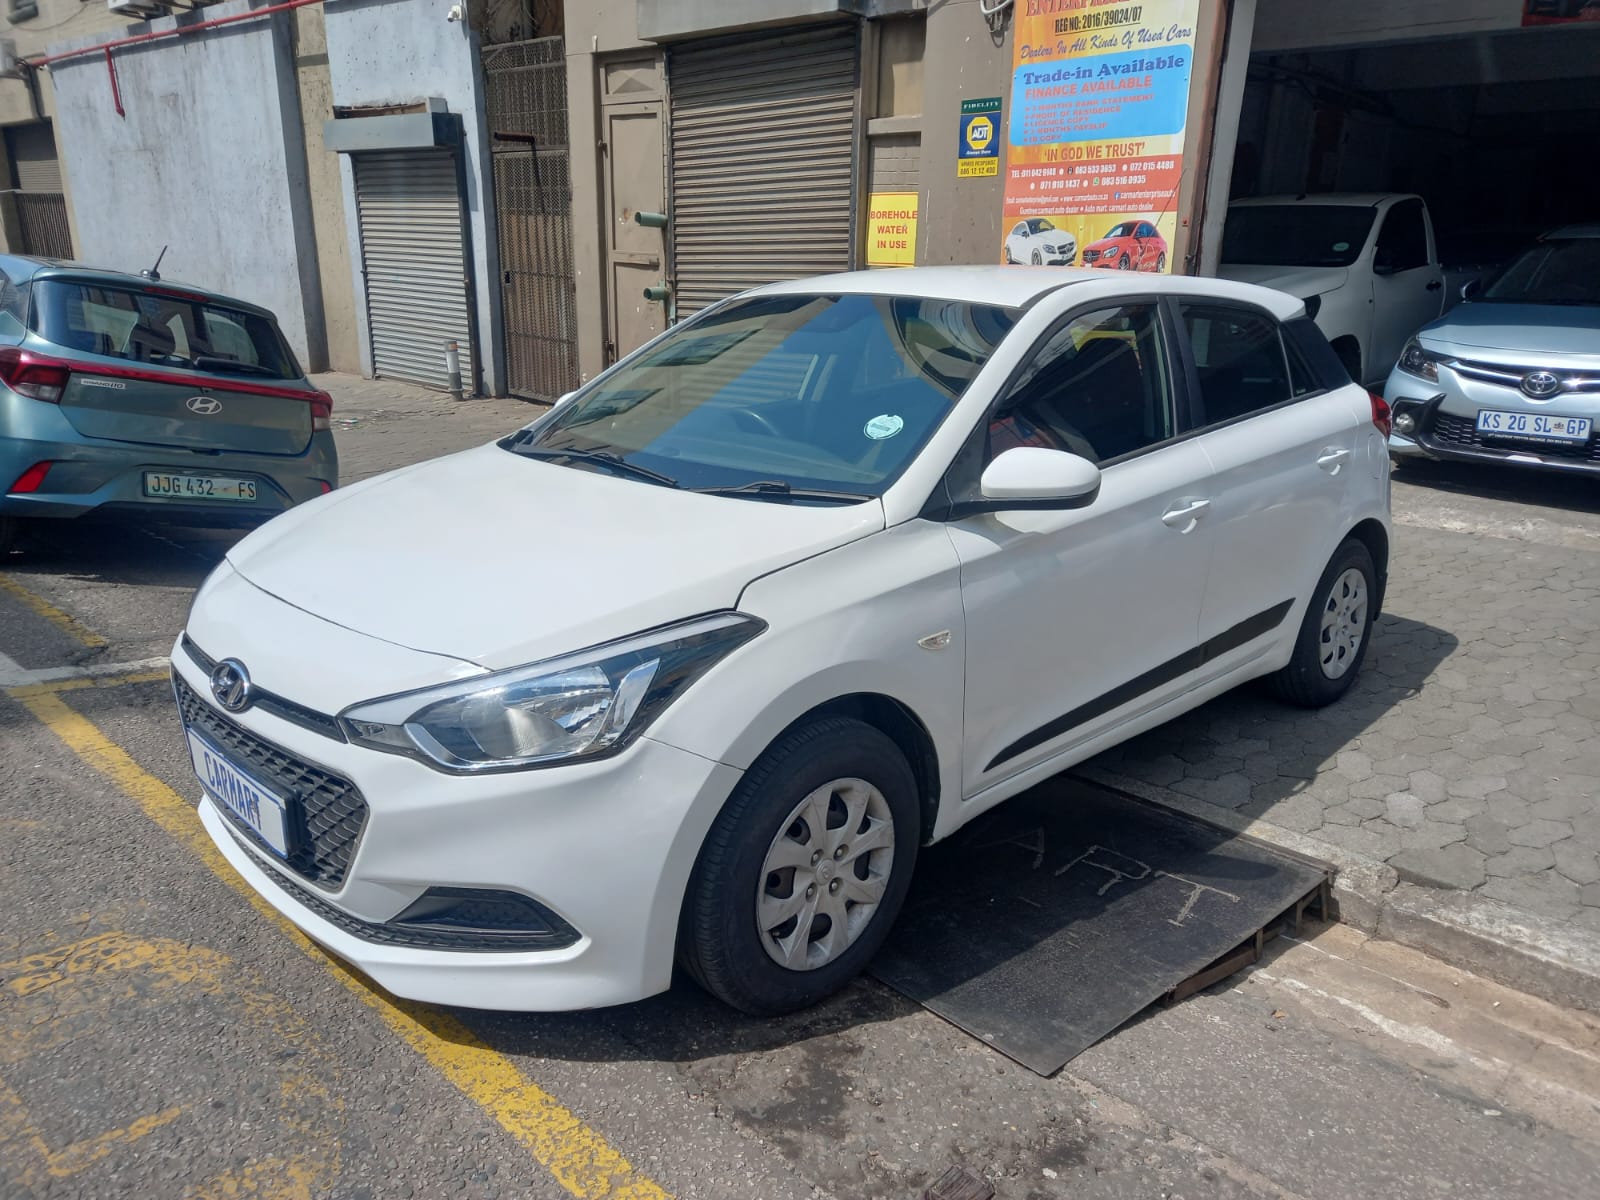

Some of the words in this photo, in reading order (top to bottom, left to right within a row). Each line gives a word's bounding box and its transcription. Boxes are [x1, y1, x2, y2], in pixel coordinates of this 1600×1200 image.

[1055, 18, 1069, 33] REG
[1082, 6, 1142, 28] 2016/39024/07
[1021, 44, 1053, 59] Dealers
[1057, 42, 1067, 55] In
[1068, 38, 1086, 54] All
[1090, 35, 1117, 49] Kinds
[1121, 31, 1134, 49] Of
[1138, 28, 1163, 43] Used
[1166, 24, 1191, 41] Cars
[1024, 66, 1093, 85] Trade-in
[1097, 55, 1185, 77] Available
[1025, 84, 1077, 99] FINANCE
[1081, 75, 1153, 94] AVAILABLE
[972, 126, 989, 139] ADT
[1061, 146, 1083, 160] GOD
[1086, 144, 1102, 159] WE
[870, 210, 918, 219] BOREHOLE
[877, 225, 908, 234] WATER
[877, 240, 886, 248] IN
[889, 240, 907, 248] USE
[1483, 412, 1501, 428] KS
[1508, 415, 1526, 430] 20
[1534, 417, 1551, 433] SL
[1567, 419, 1586, 434] GP
[152, 475, 181, 493] JJG
[186, 478, 214, 495] 432
[238, 481, 255, 497] FS
[204, 751, 261, 831] CARMART
